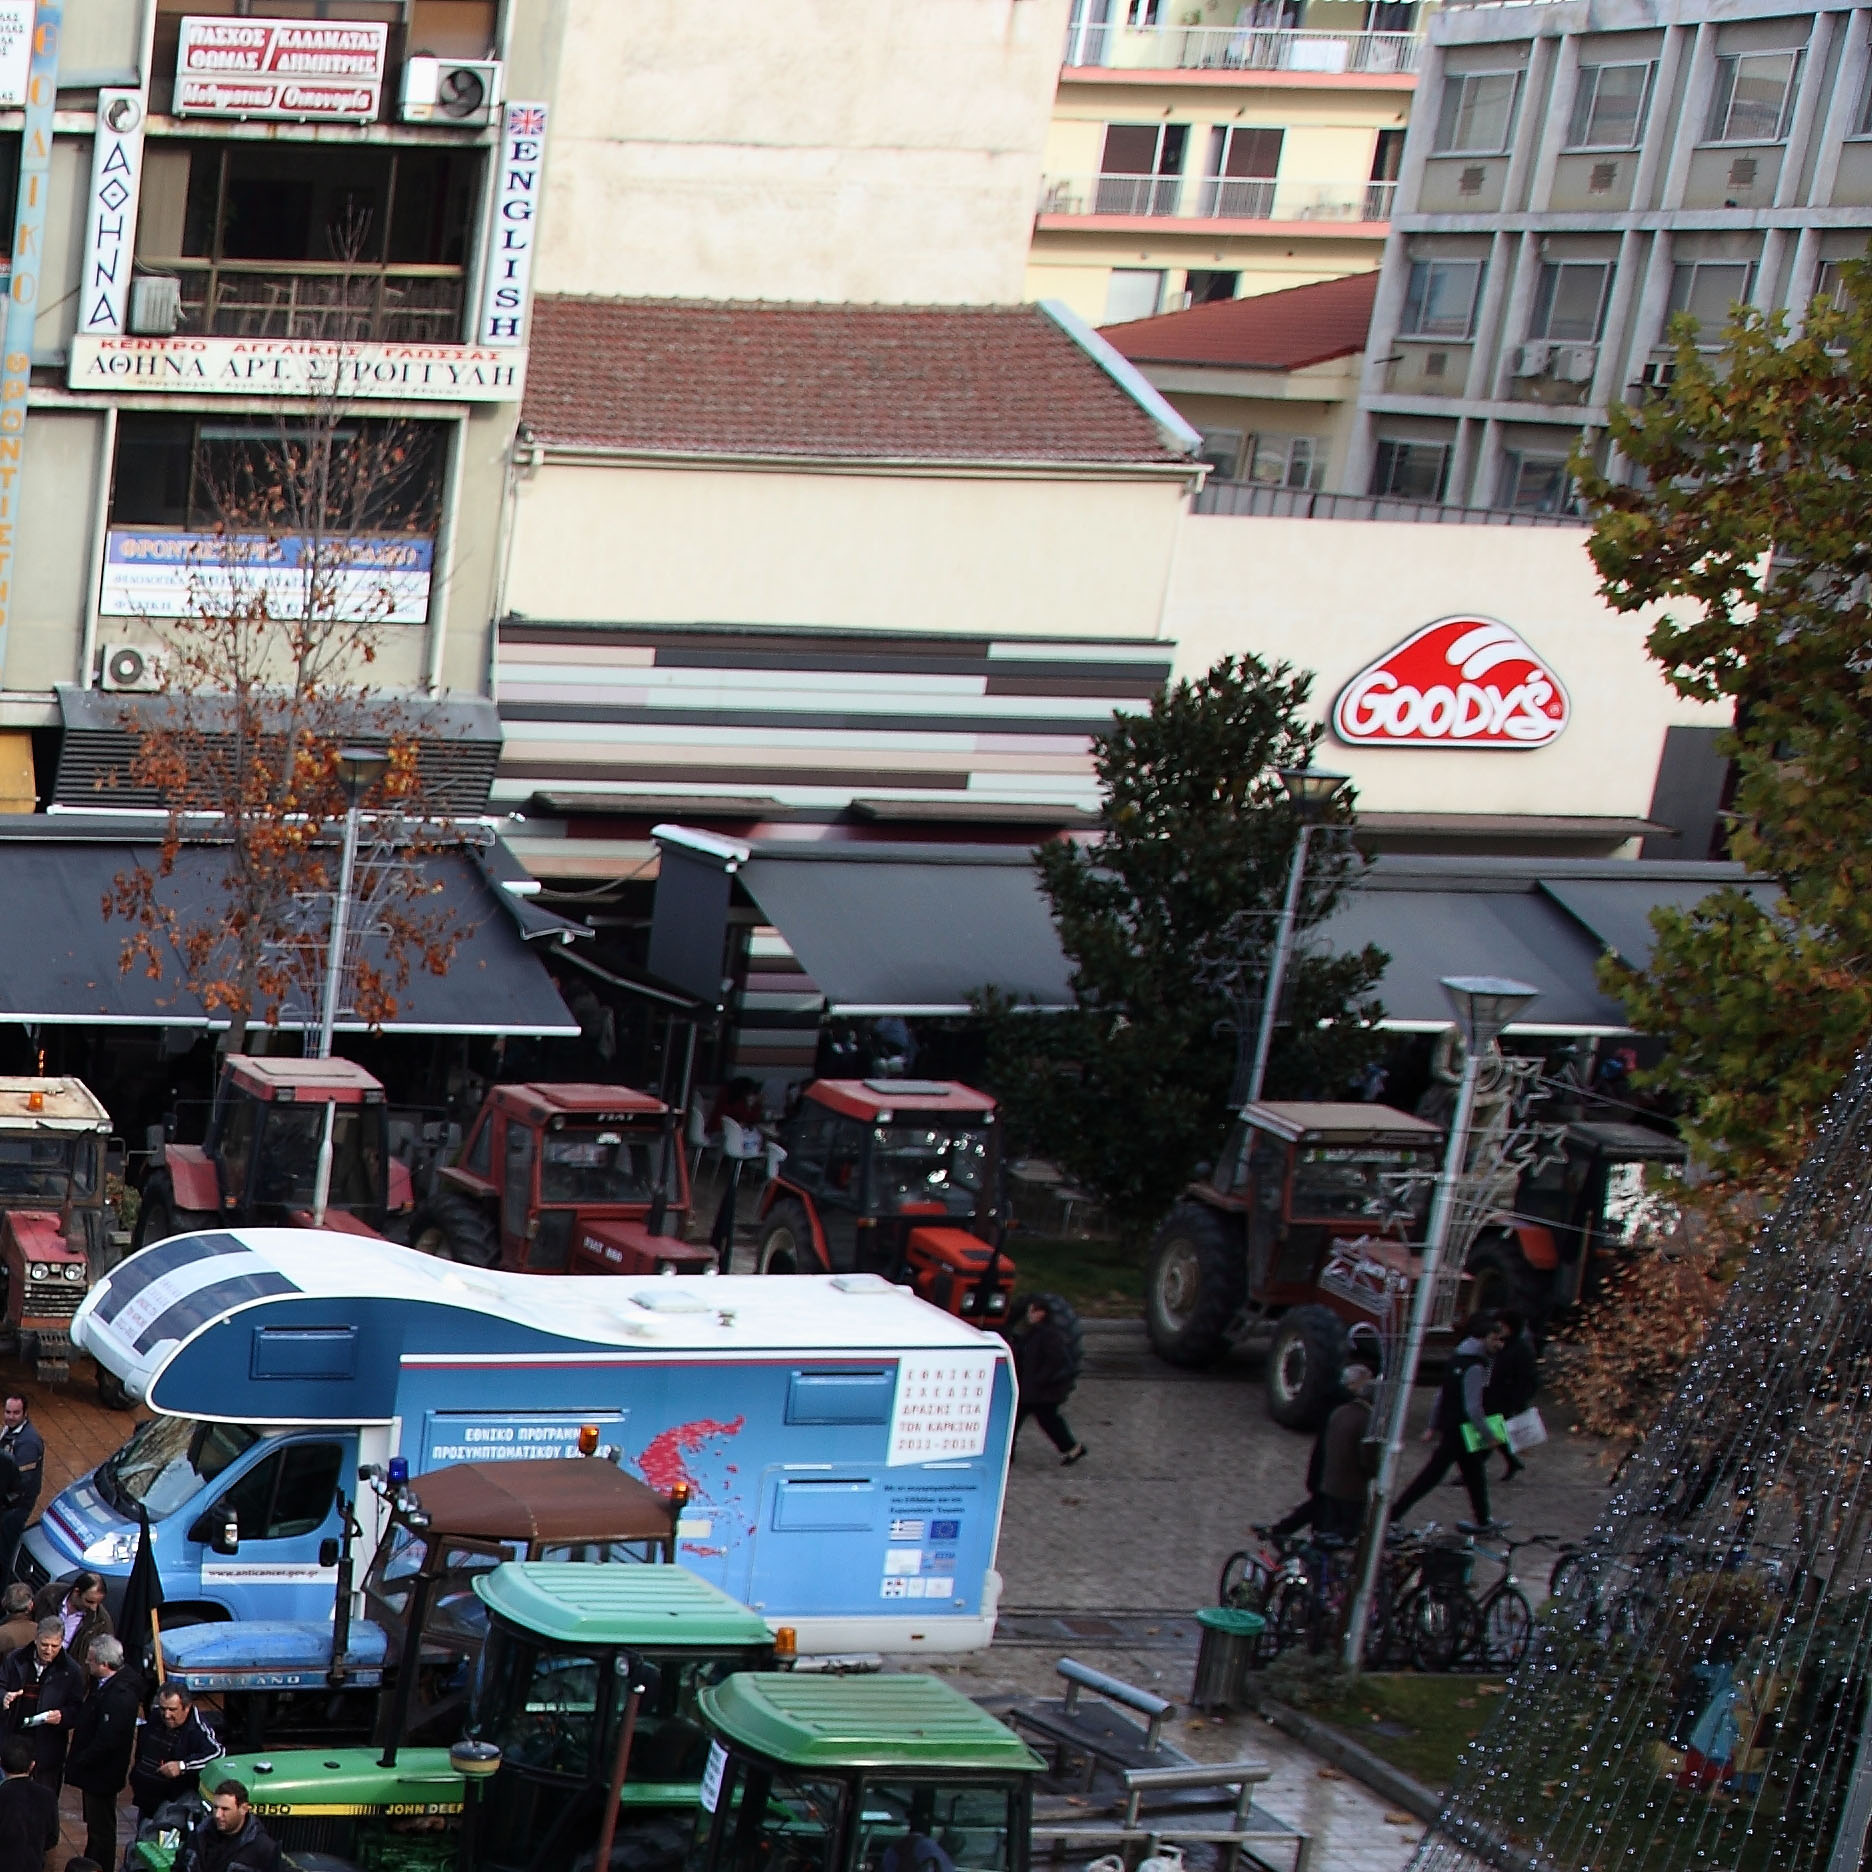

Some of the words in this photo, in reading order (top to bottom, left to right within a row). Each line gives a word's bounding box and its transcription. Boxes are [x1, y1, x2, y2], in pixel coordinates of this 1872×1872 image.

[89, 142, 131, 327] ΑΘΗΝΑ
[488, 141, 539, 337] ENGLISH
[101, 339, 207, 352] ΚΕΝΤΡΟ
[384, 347, 503, 361] ΓΛΩΣΣΑΣ
[87, 353, 206, 378] ΑΘΗΝΑ
[1344, 669, 1563, 740] GOODY'S
[464, 1427, 514, 1442] ΕΘΝΙΚΟ
[385, 1803, 424, 1815] JOHN
